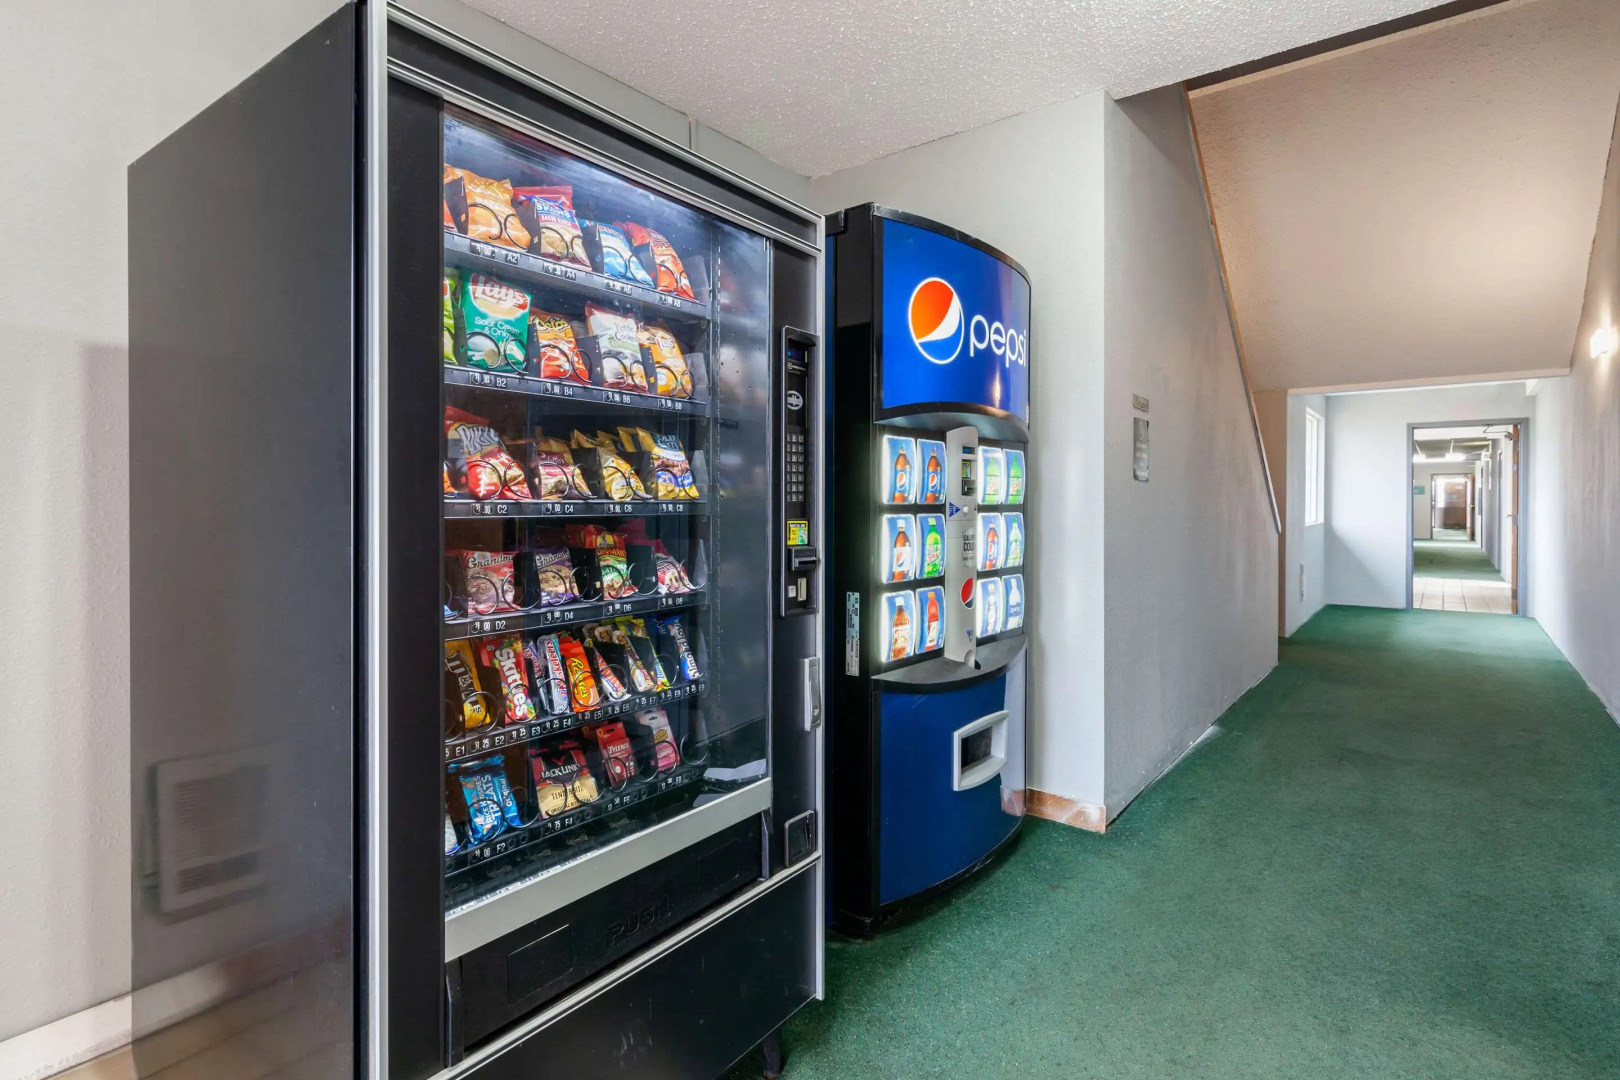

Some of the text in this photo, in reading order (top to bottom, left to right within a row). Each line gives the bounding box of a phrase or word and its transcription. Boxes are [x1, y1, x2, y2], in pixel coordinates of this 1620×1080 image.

[474, 316, 520, 335] Sour Cream
[969, 314, 1027, 369] pepsi
[496, 377, 507, 388] B2
[564, 387, 573, 396] B4
[622, 394, 631, 404] B6
[497, 504, 508, 514] C2
[564, 504, 574, 514] C4
[623, 603, 632, 613] D6
[564, 611, 574, 621] D4
[495, 620, 506, 631] D2
[622, 703, 630, 712] E6
[594, 710, 602, 720] E5
[562, 718, 572, 728] E4
[531, 726, 541, 737] E3
[494, 736, 505, 746] E2
[455, 745, 465, 757] E1
[541, 766, 562, 779] JACK
[482, 806, 492, 825] RICE
[496, 842, 506, 854] F2
[607, 894, 673, 947] PUSH
